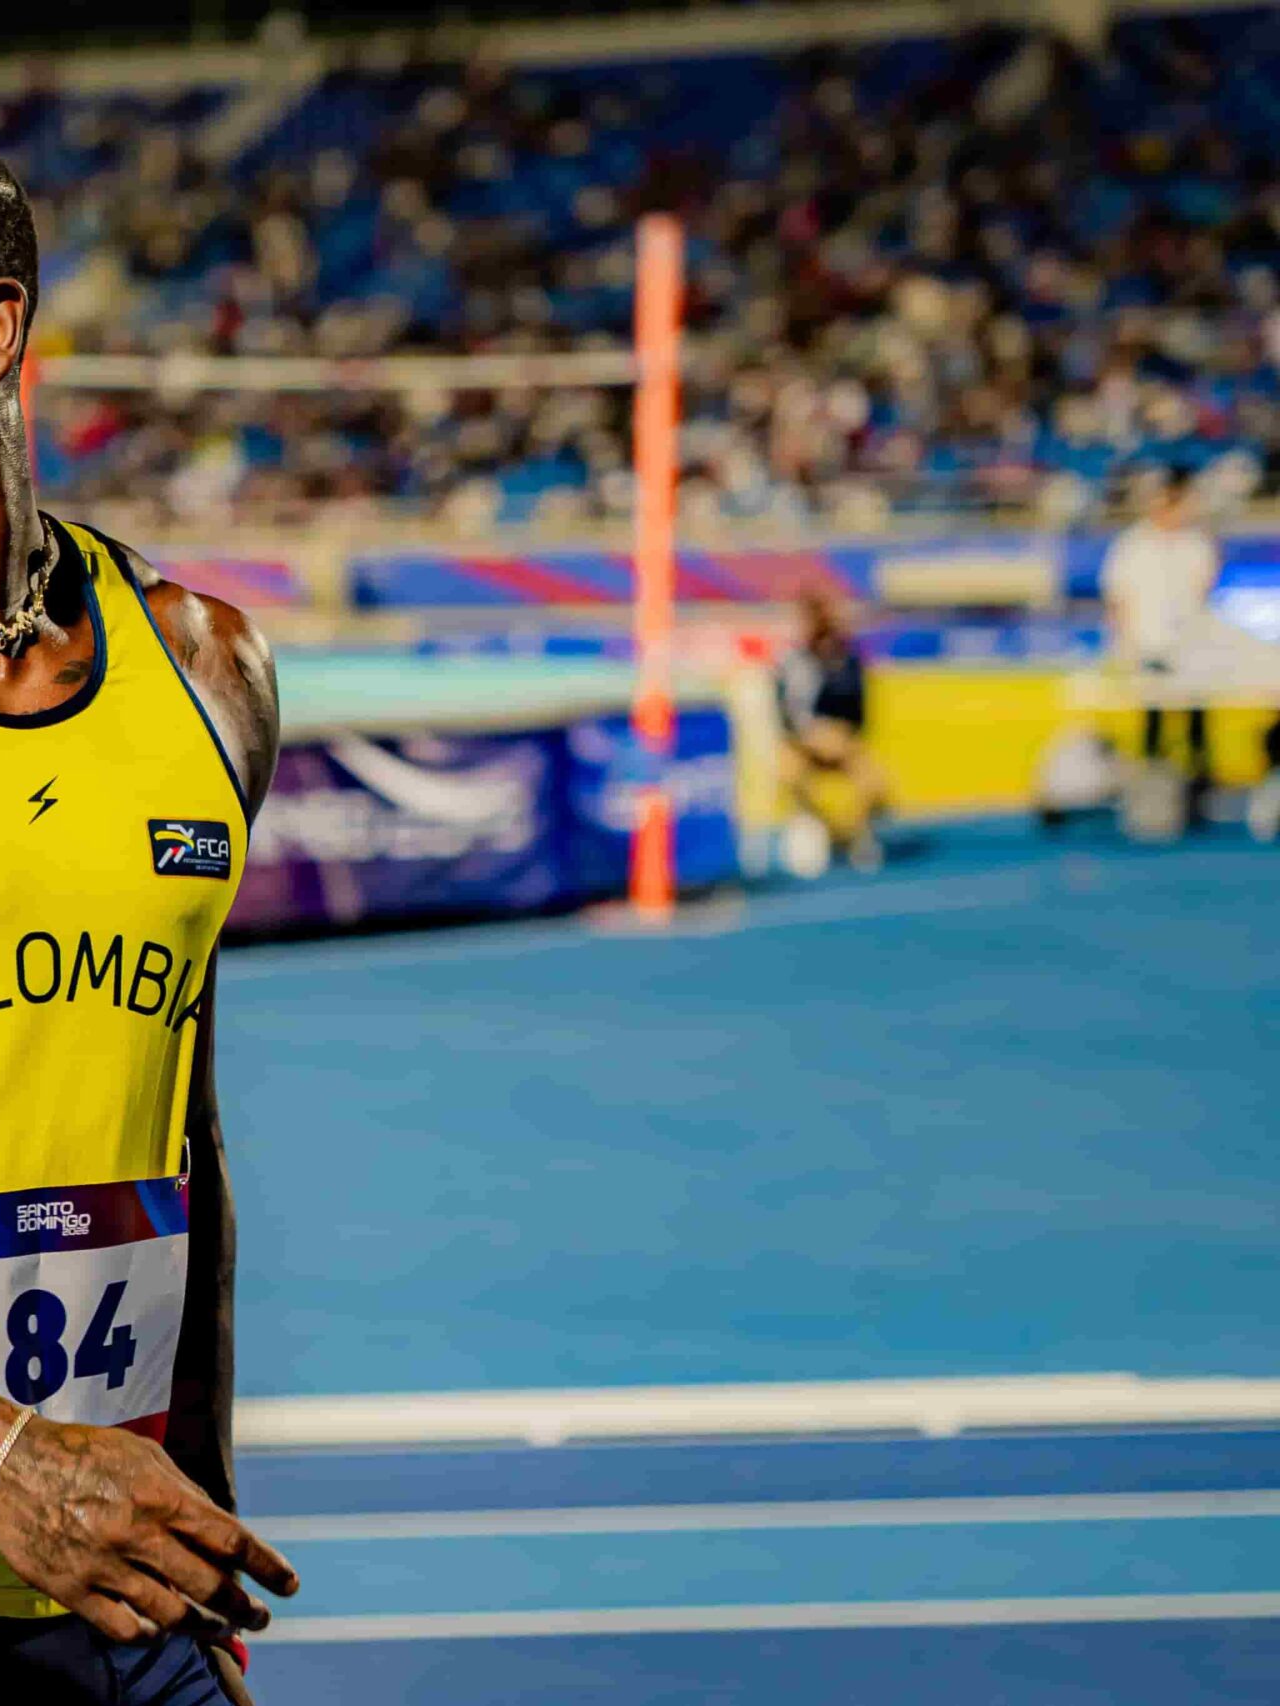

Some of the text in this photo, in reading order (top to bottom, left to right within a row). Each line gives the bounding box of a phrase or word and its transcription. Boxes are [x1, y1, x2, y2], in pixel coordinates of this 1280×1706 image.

[196, 838, 229, 859] FCA
[17, 1201, 74, 1219] SANTO
[17, 1213, 91, 1233] DOMINGO
